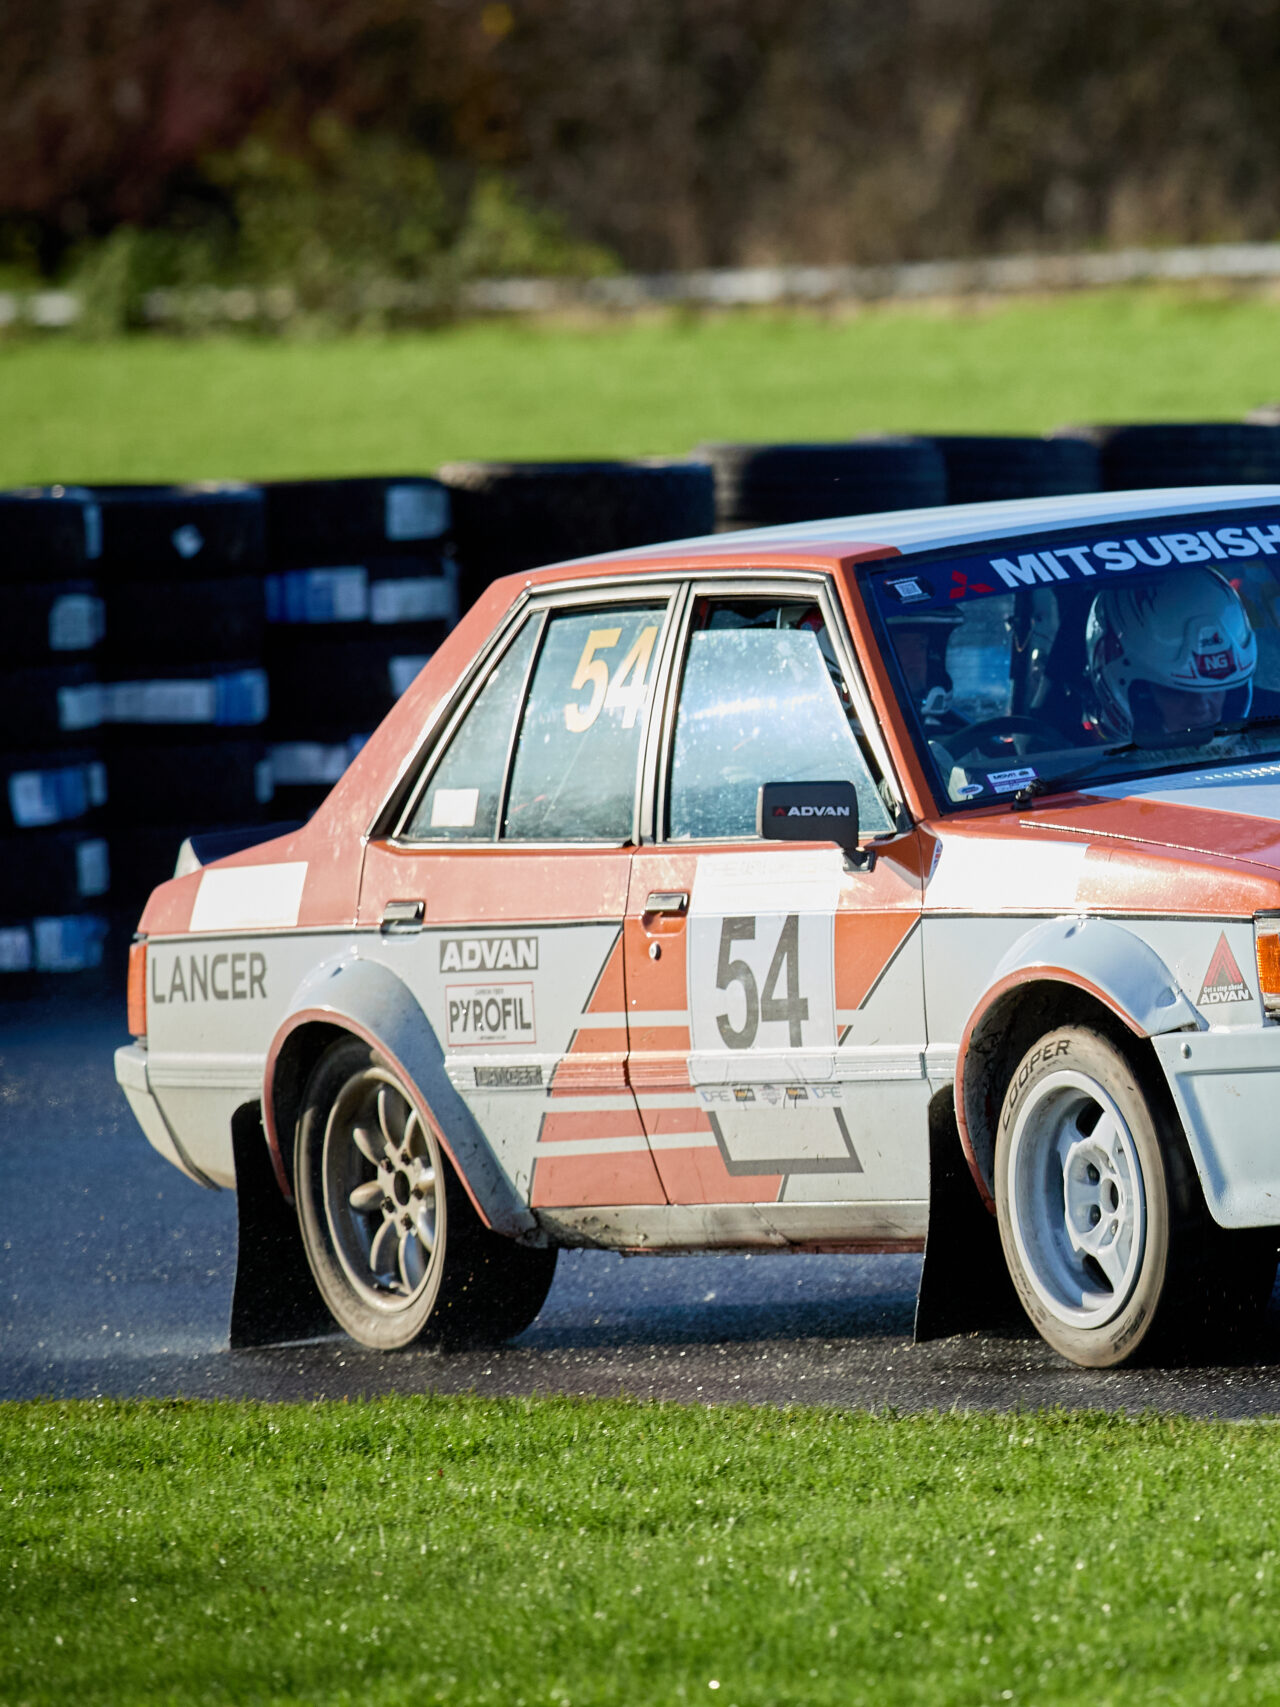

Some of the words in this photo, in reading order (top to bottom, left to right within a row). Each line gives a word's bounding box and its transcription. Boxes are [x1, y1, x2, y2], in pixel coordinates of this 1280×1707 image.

[564, 626, 659, 733] 54
[1203, 653, 1229, 671] NG
[787, 806, 850, 817] ADVAN
[440, 938, 538, 972] ADVAN
[152, 952, 268, 1004] LANCER
[716, 911, 809, 1050] 54
[449, 997, 532, 1033] PYROFIL
[1199, 989, 1250, 1005] ADVAN
[1003, 1040, 1070, 1132] COOPER
